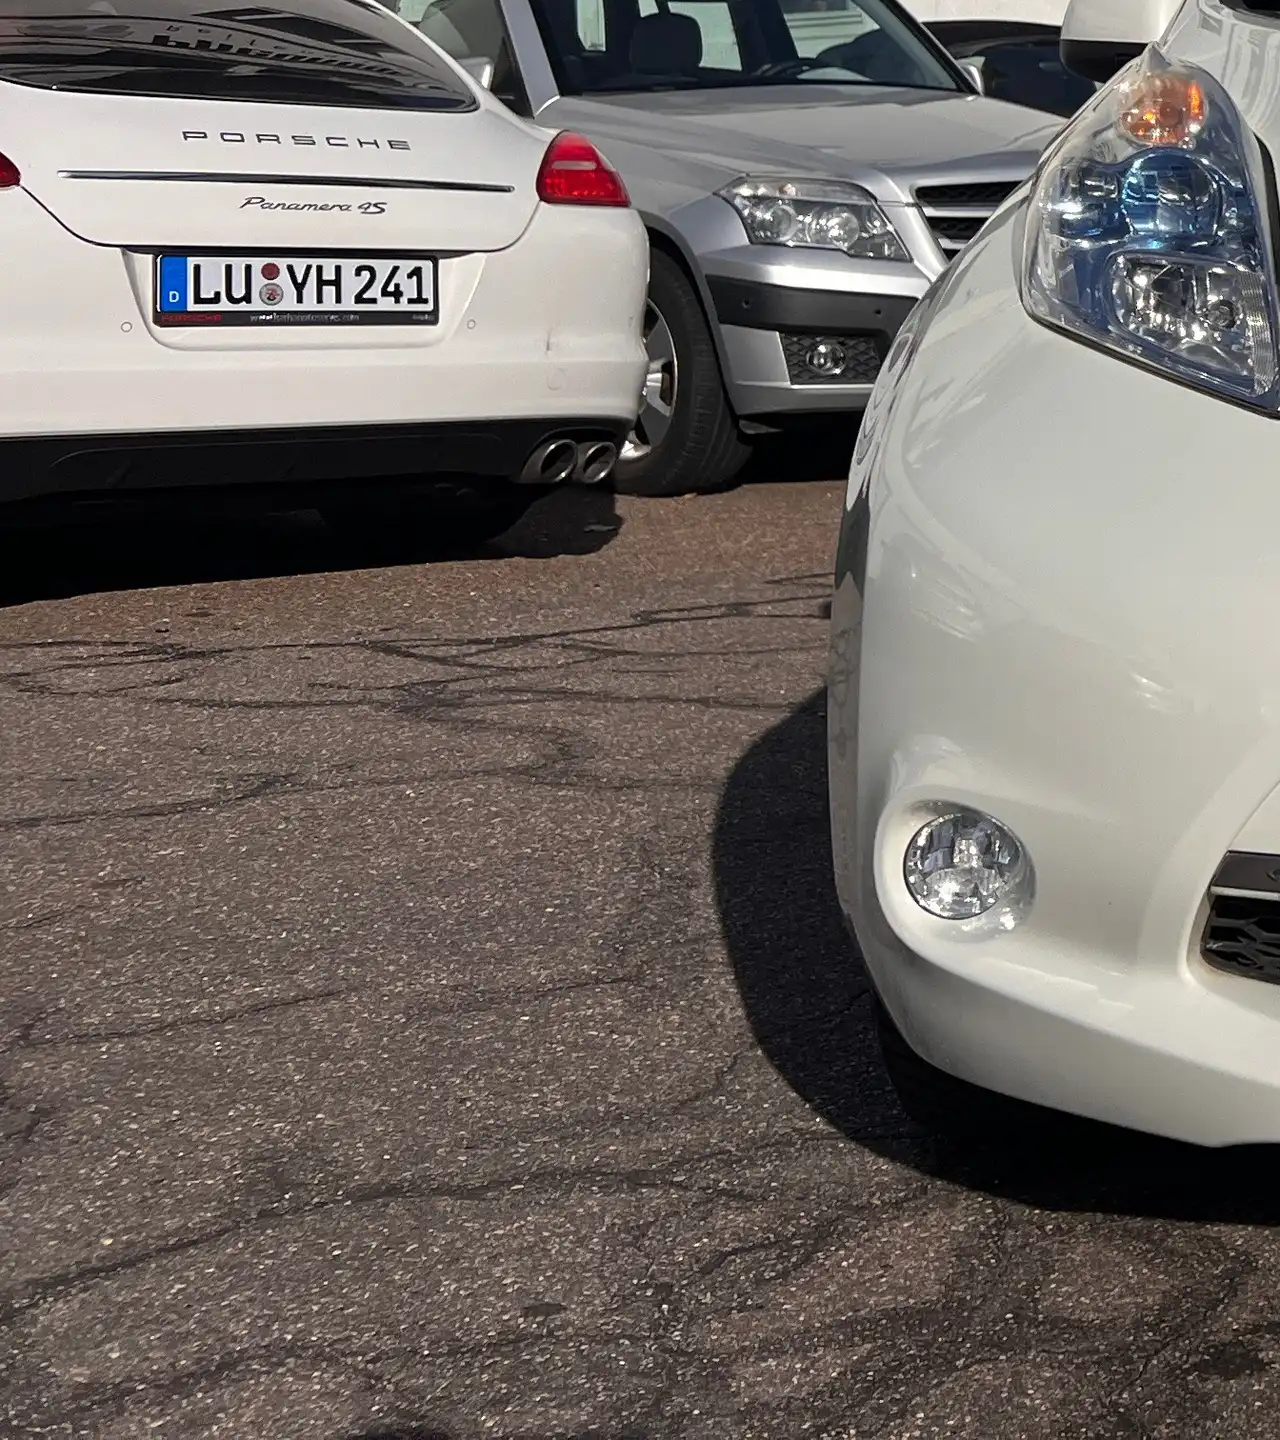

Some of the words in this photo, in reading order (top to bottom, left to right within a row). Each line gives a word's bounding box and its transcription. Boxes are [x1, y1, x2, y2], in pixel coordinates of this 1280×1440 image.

[182, 130, 411, 151] PORSCHE
[240, 196, 352, 211] Panamera
[357, 202, 387, 214] 4S
[193, 263, 252, 305] LU
[286, 264, 342, 305] YH
[354, 265, 429, 305] 241
